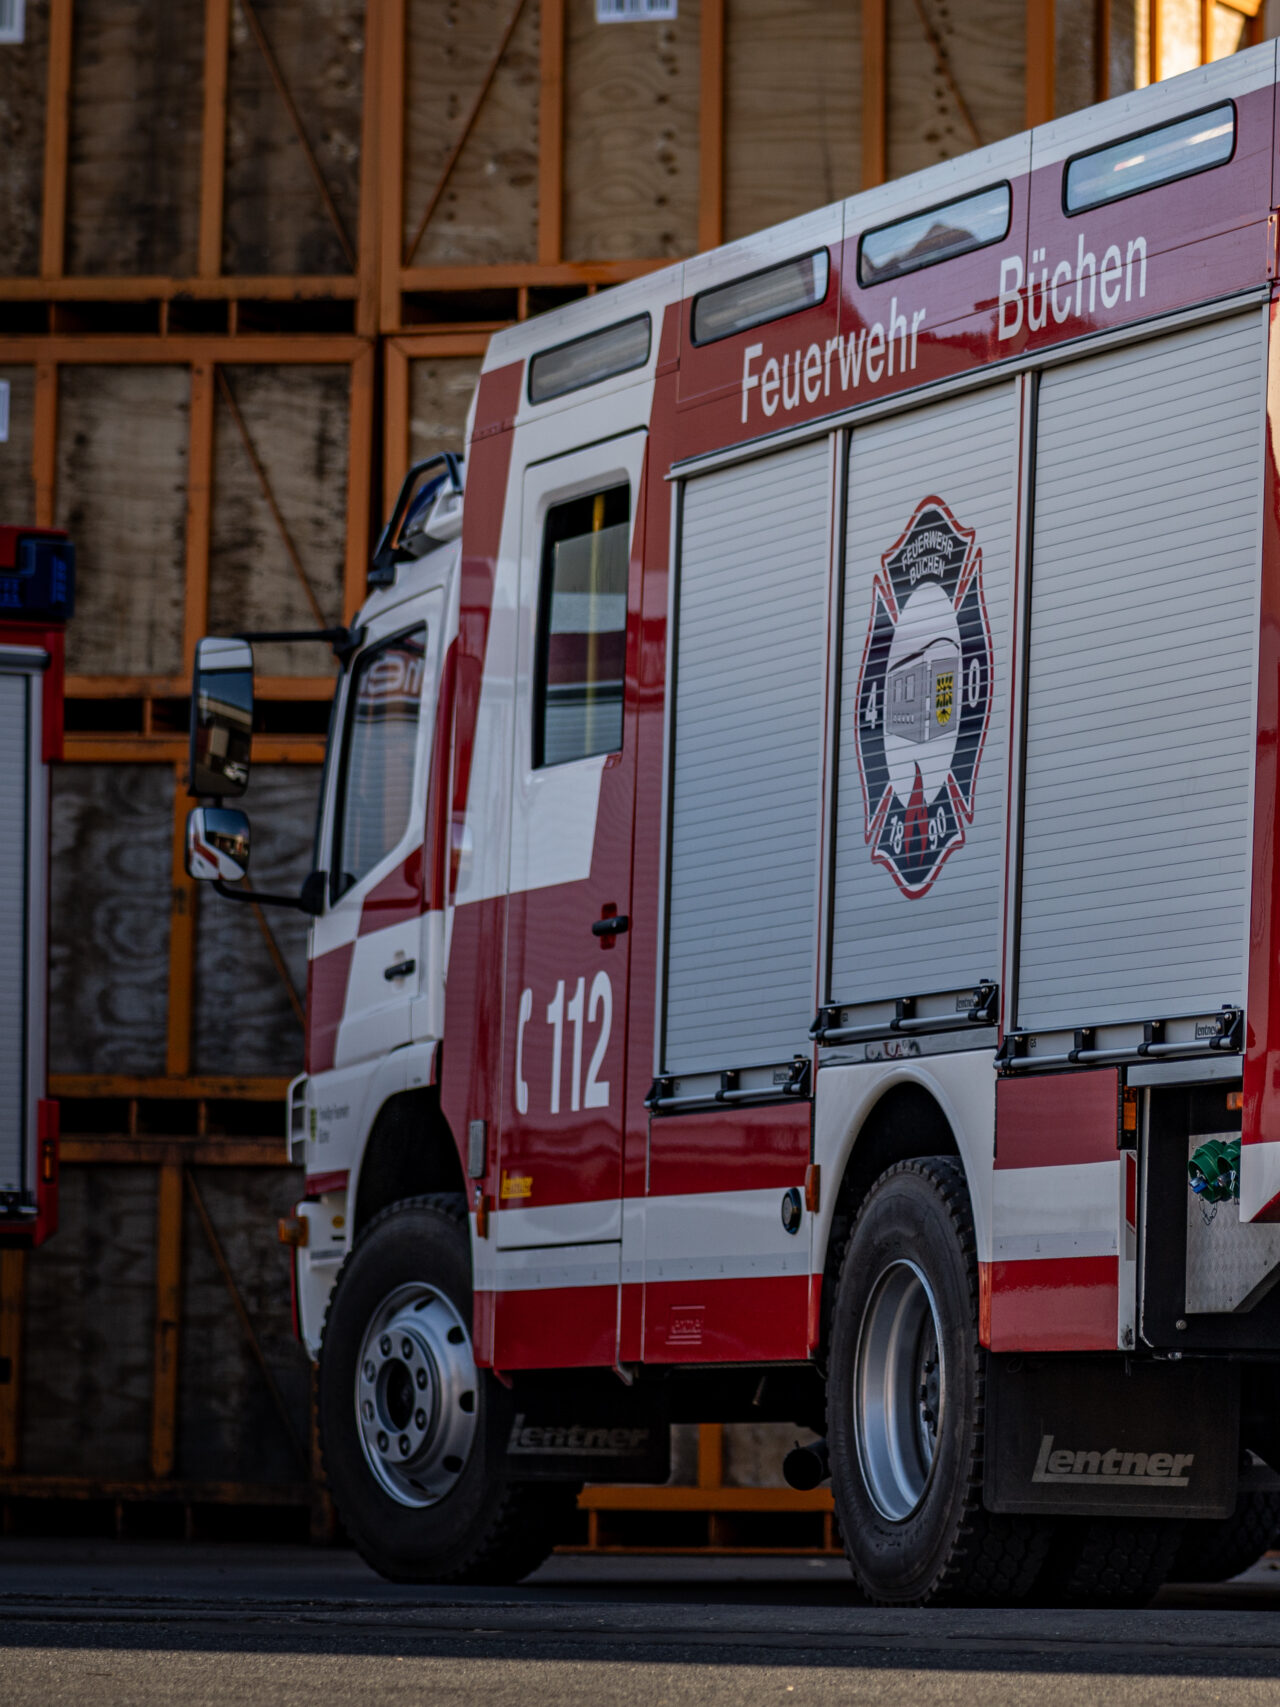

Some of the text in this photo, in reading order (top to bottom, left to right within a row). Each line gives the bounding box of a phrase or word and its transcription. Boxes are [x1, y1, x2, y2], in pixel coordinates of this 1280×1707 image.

[741, 233, 1148, 424] Feuerwehr Büchen
[901, 530, 954, 572] FEUERWEHR
[865, 658, 980, 729] 4 0
[889, 806, 947, 855] 18 90
[547, 969, 612, 1114] 112
[506, 1413, 649, 1455] Lentner
[1031, 1434, 1195, 1487] Lentner
